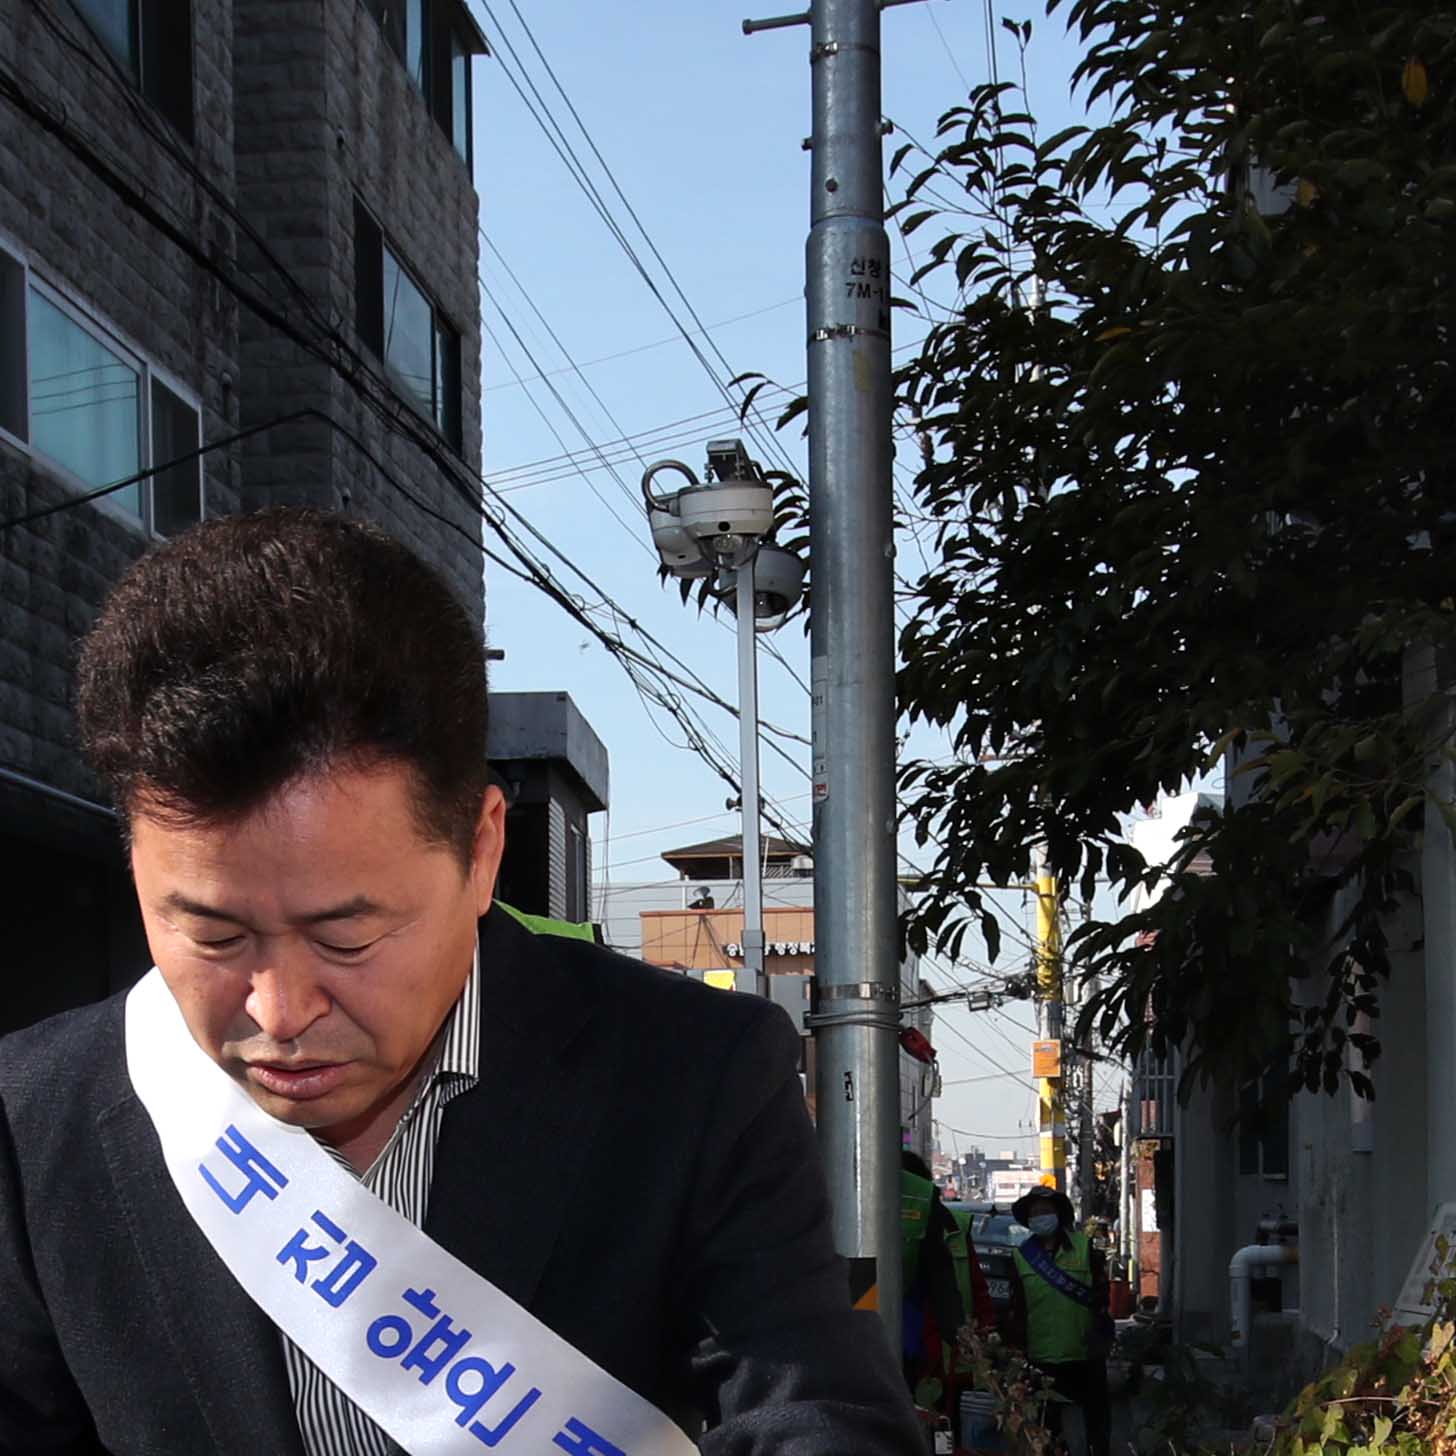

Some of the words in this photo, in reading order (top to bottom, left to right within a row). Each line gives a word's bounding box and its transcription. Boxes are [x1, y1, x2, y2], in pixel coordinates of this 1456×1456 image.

[197, 1123, 289, 1216] 내
[275, 1209, 379, 1310] 집
[365, 1285, 543, 1449] 앞은
